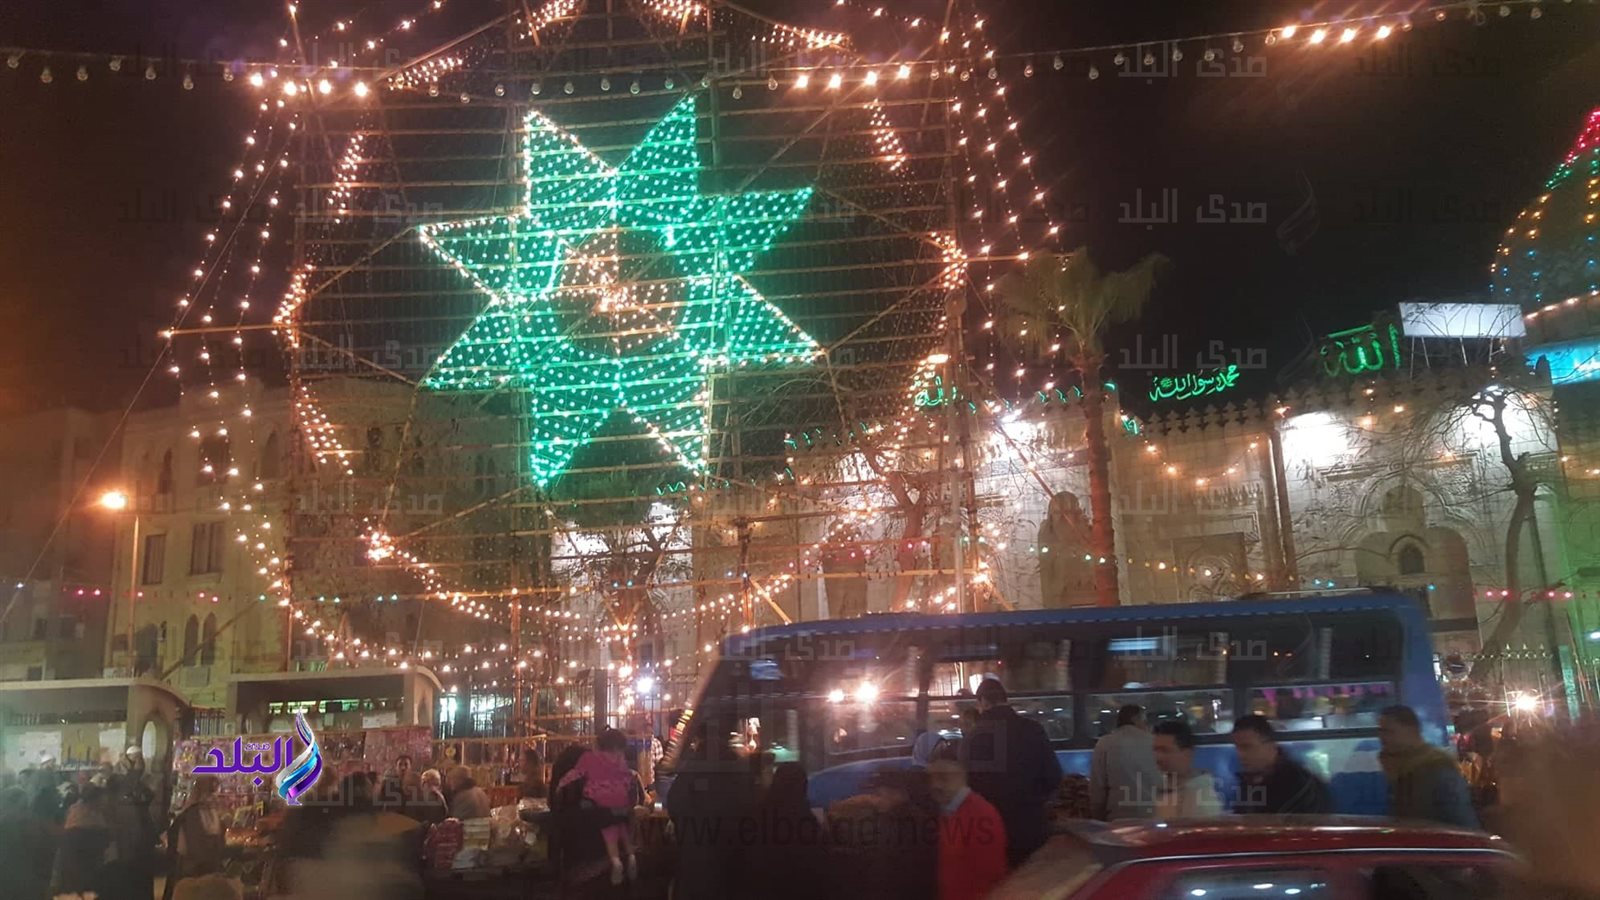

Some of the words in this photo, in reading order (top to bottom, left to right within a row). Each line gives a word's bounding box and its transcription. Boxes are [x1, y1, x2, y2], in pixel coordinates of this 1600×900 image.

[1320, 323, 1401, 377] الله
[1149, 374, 1191, 401] الله
[1215, 364, 1240, 392] محمد
